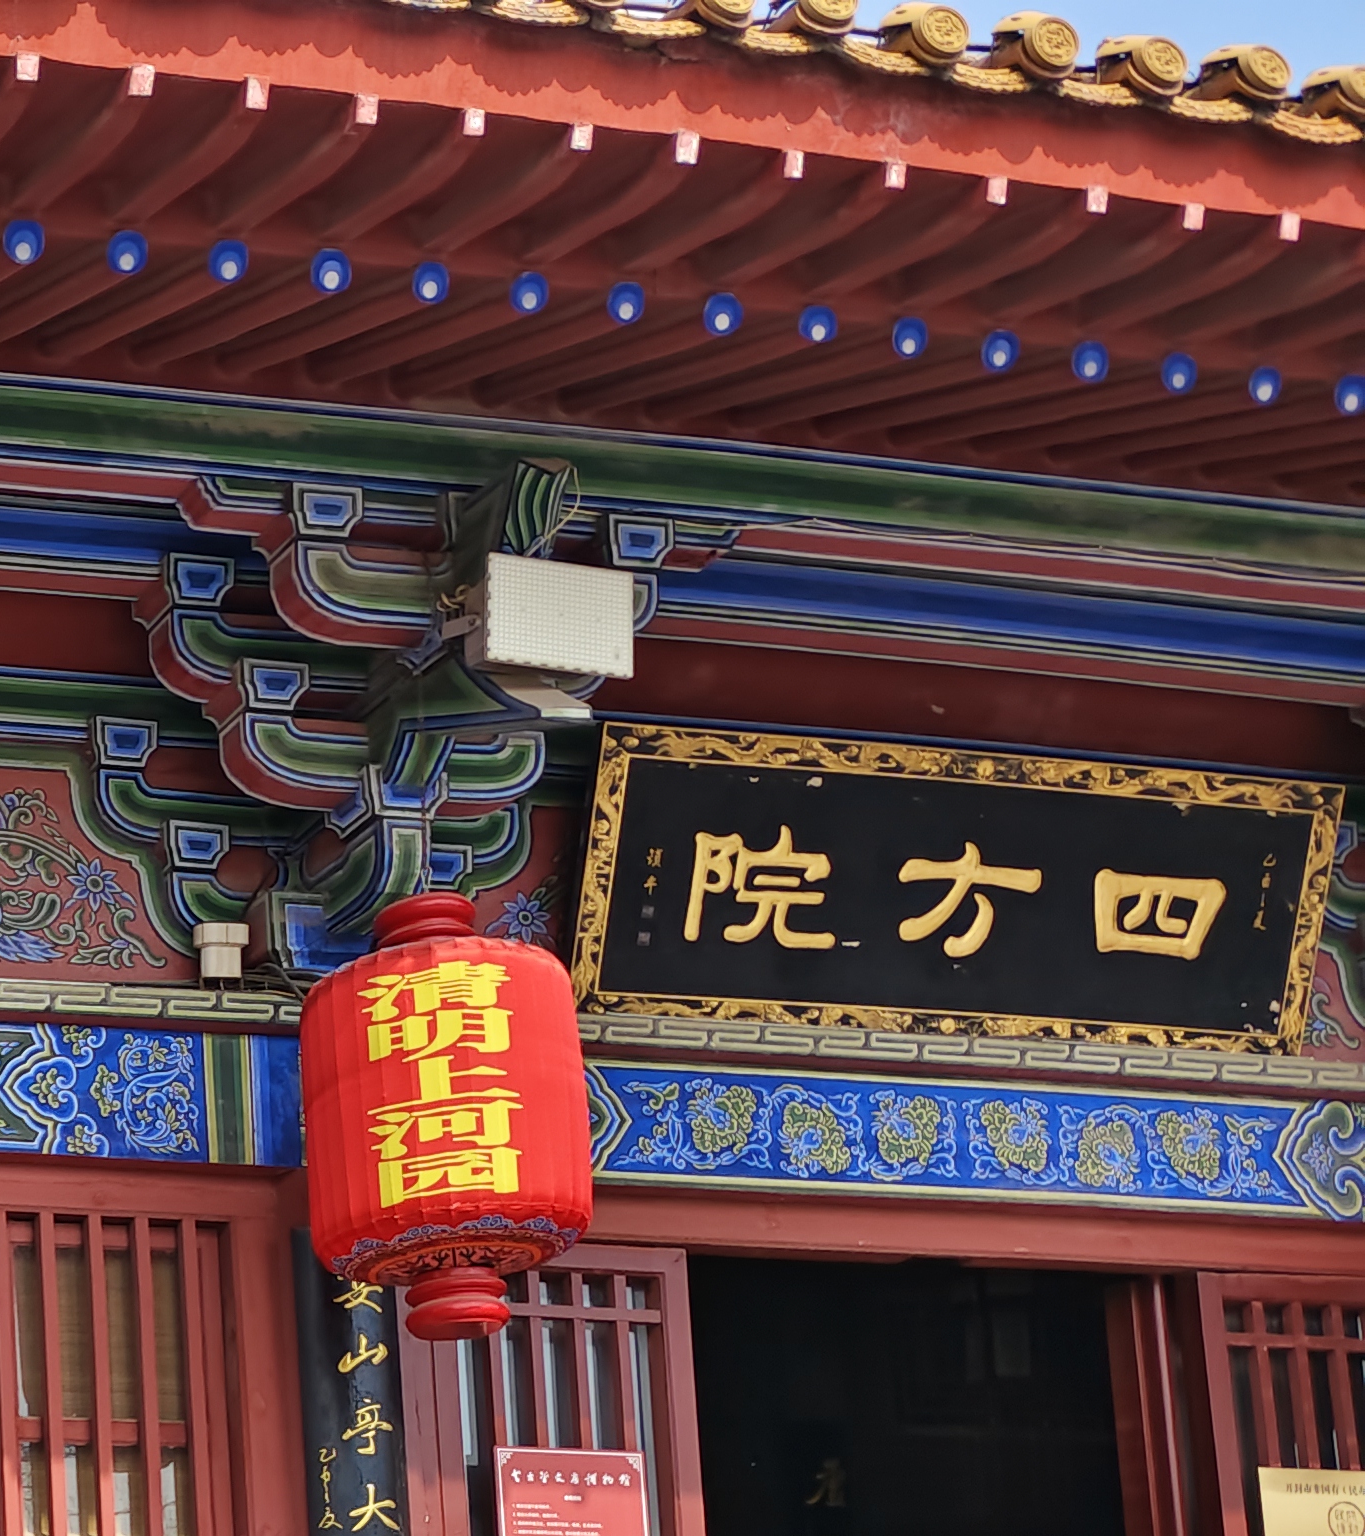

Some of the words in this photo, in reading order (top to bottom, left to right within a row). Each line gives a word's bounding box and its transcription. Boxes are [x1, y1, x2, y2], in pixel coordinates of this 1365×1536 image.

[683, 825, 1228, 961] 四方院
[357, 960, 523, 1208] 清明上河园
